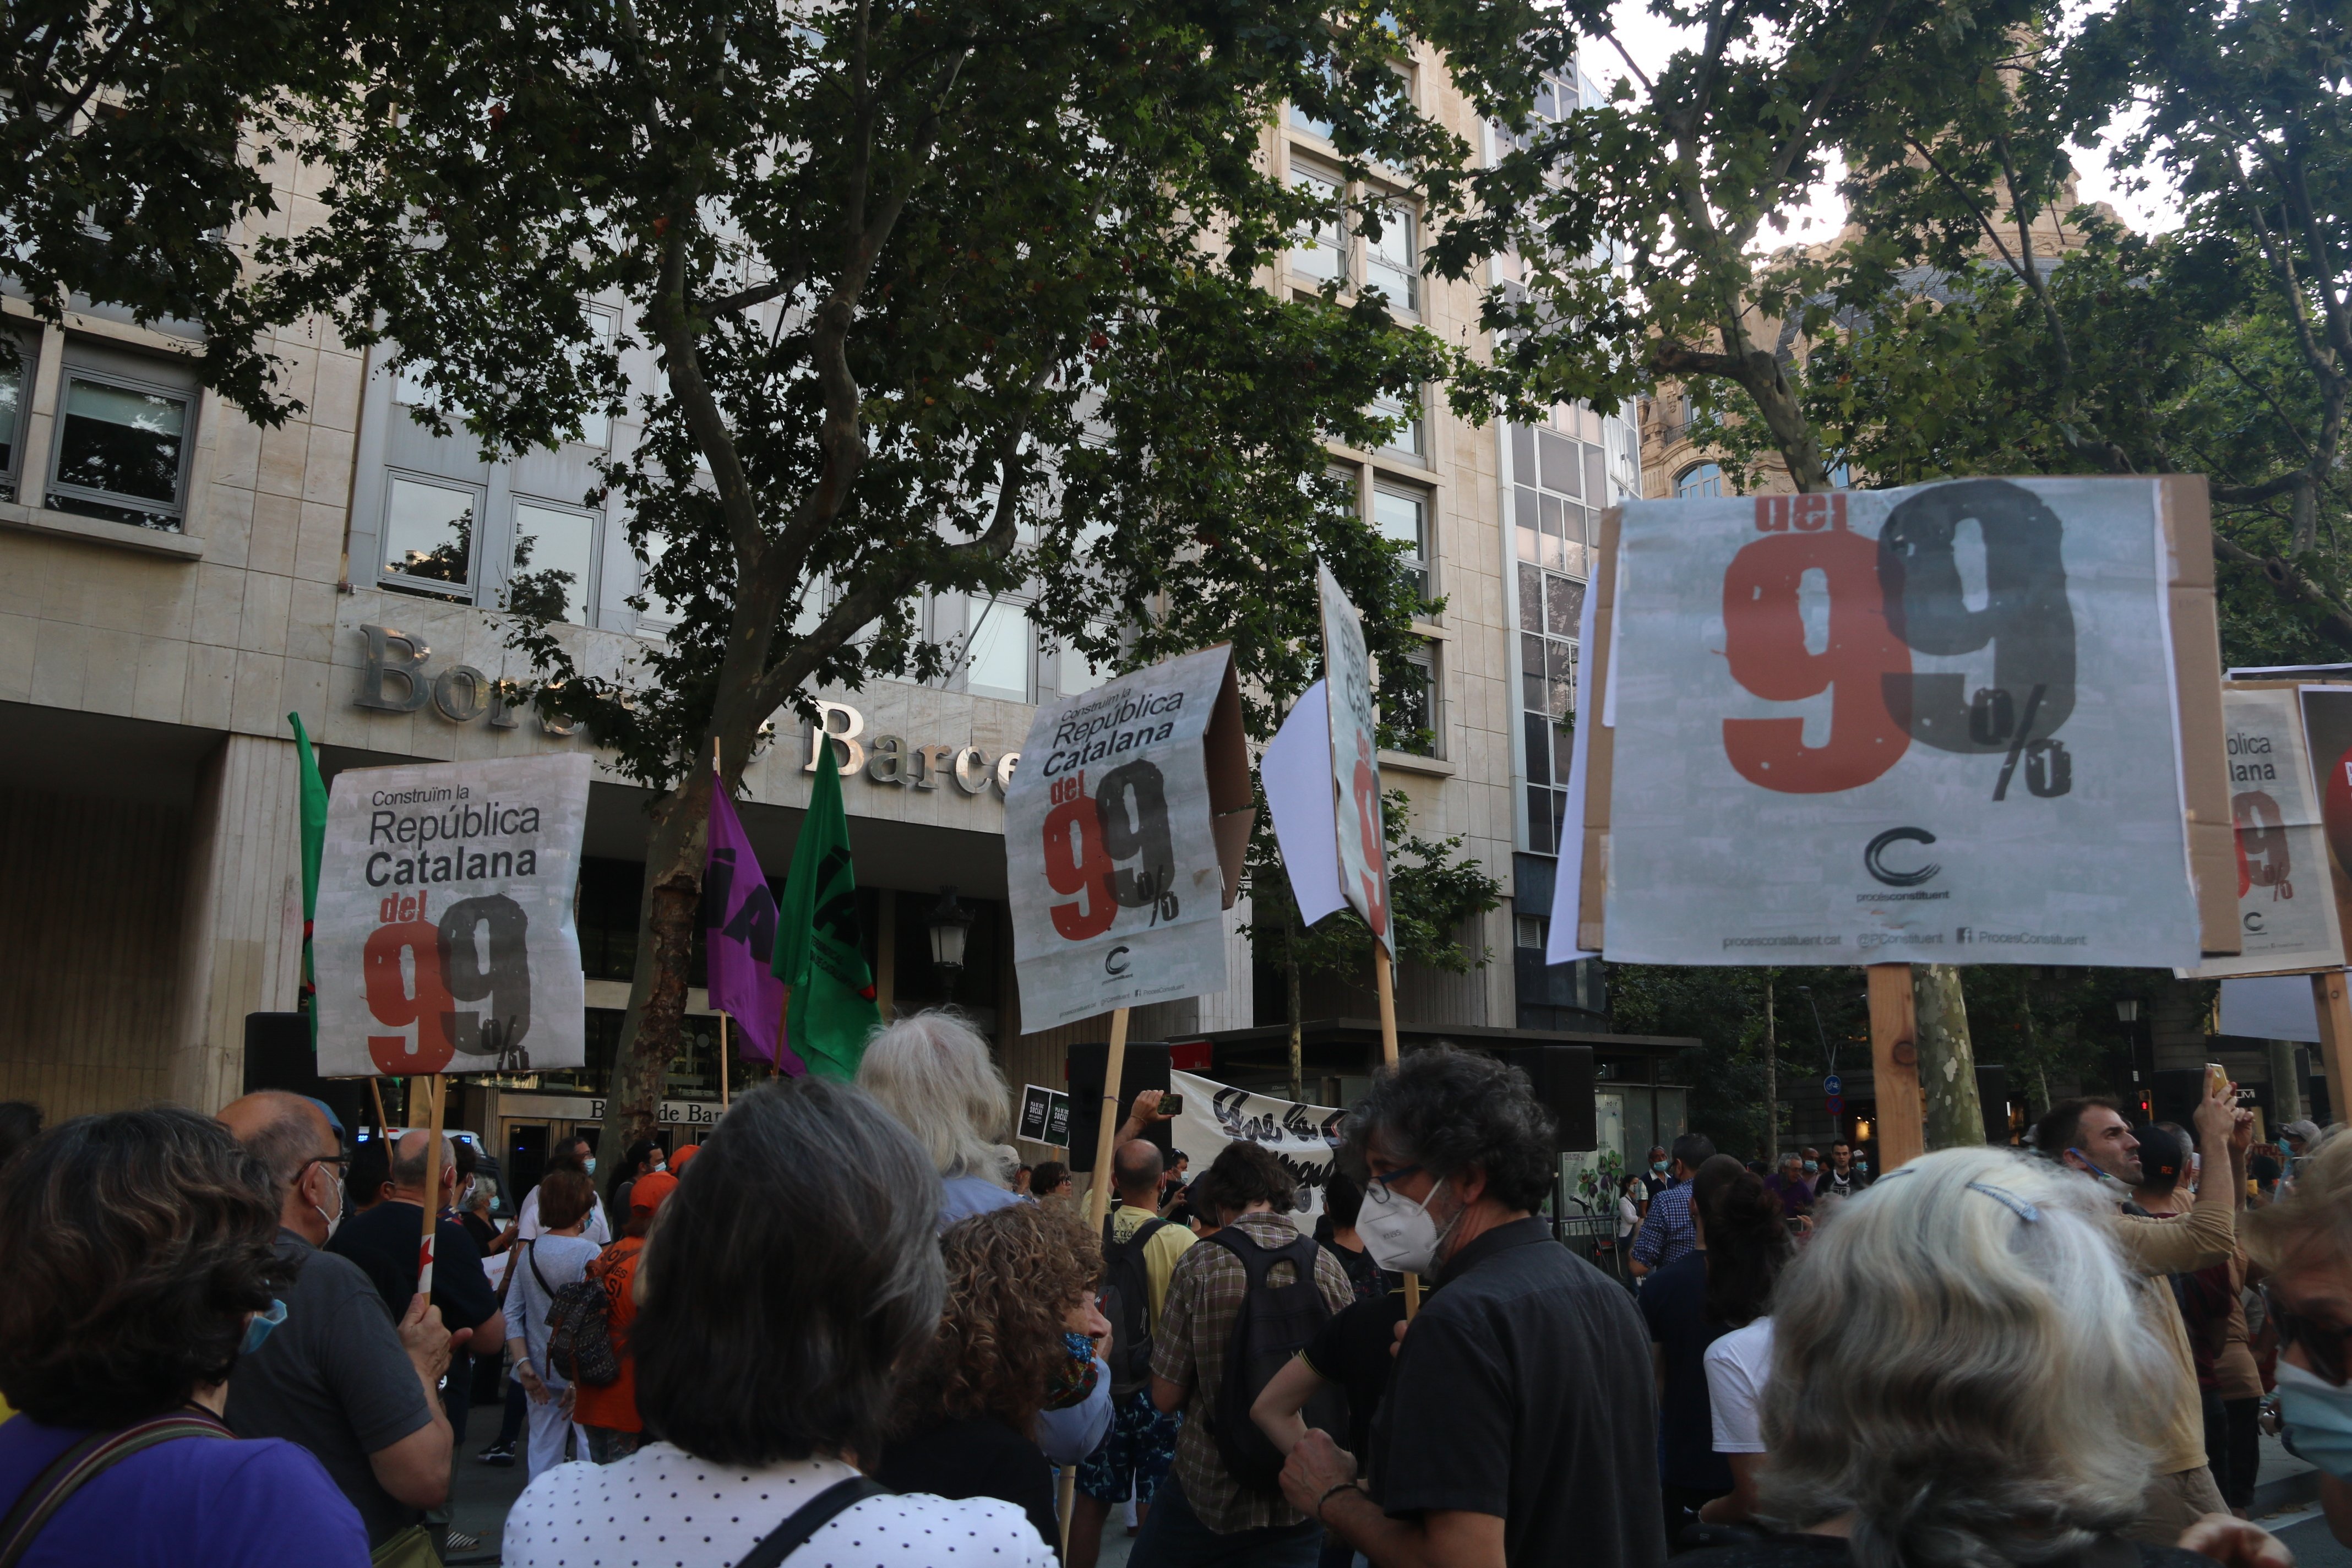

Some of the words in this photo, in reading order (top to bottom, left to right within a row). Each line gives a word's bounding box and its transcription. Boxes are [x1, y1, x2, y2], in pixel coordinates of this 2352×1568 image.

[1053, 692, 1184, 749] República
[1061, 689, 1120, 722] Construïm
[1120, 686, 1131, 700] la
[1043, 721, 1174, 777] Catalana
[2228, 733, 2272, 755] blica
[1050, 769, 1085, 805] del
[2229, 760, 2277, 782] lana
[372, 785, 451, 807] Construïm
[455, 783, 470, 801] la
[368, 802, 541, 850] República
[365, 846, 537, 888] Catalana
[1042, 758, 1179, 941] 99%
[379, 889, 428, 923] del
[362, 892, 531, 1074] 99%
[660, 1103, 679, 1121] de
[1030, 1106, 1043, 1115] SOCIAL
[1054, 1112, 1068, 1121] SOCIAL
